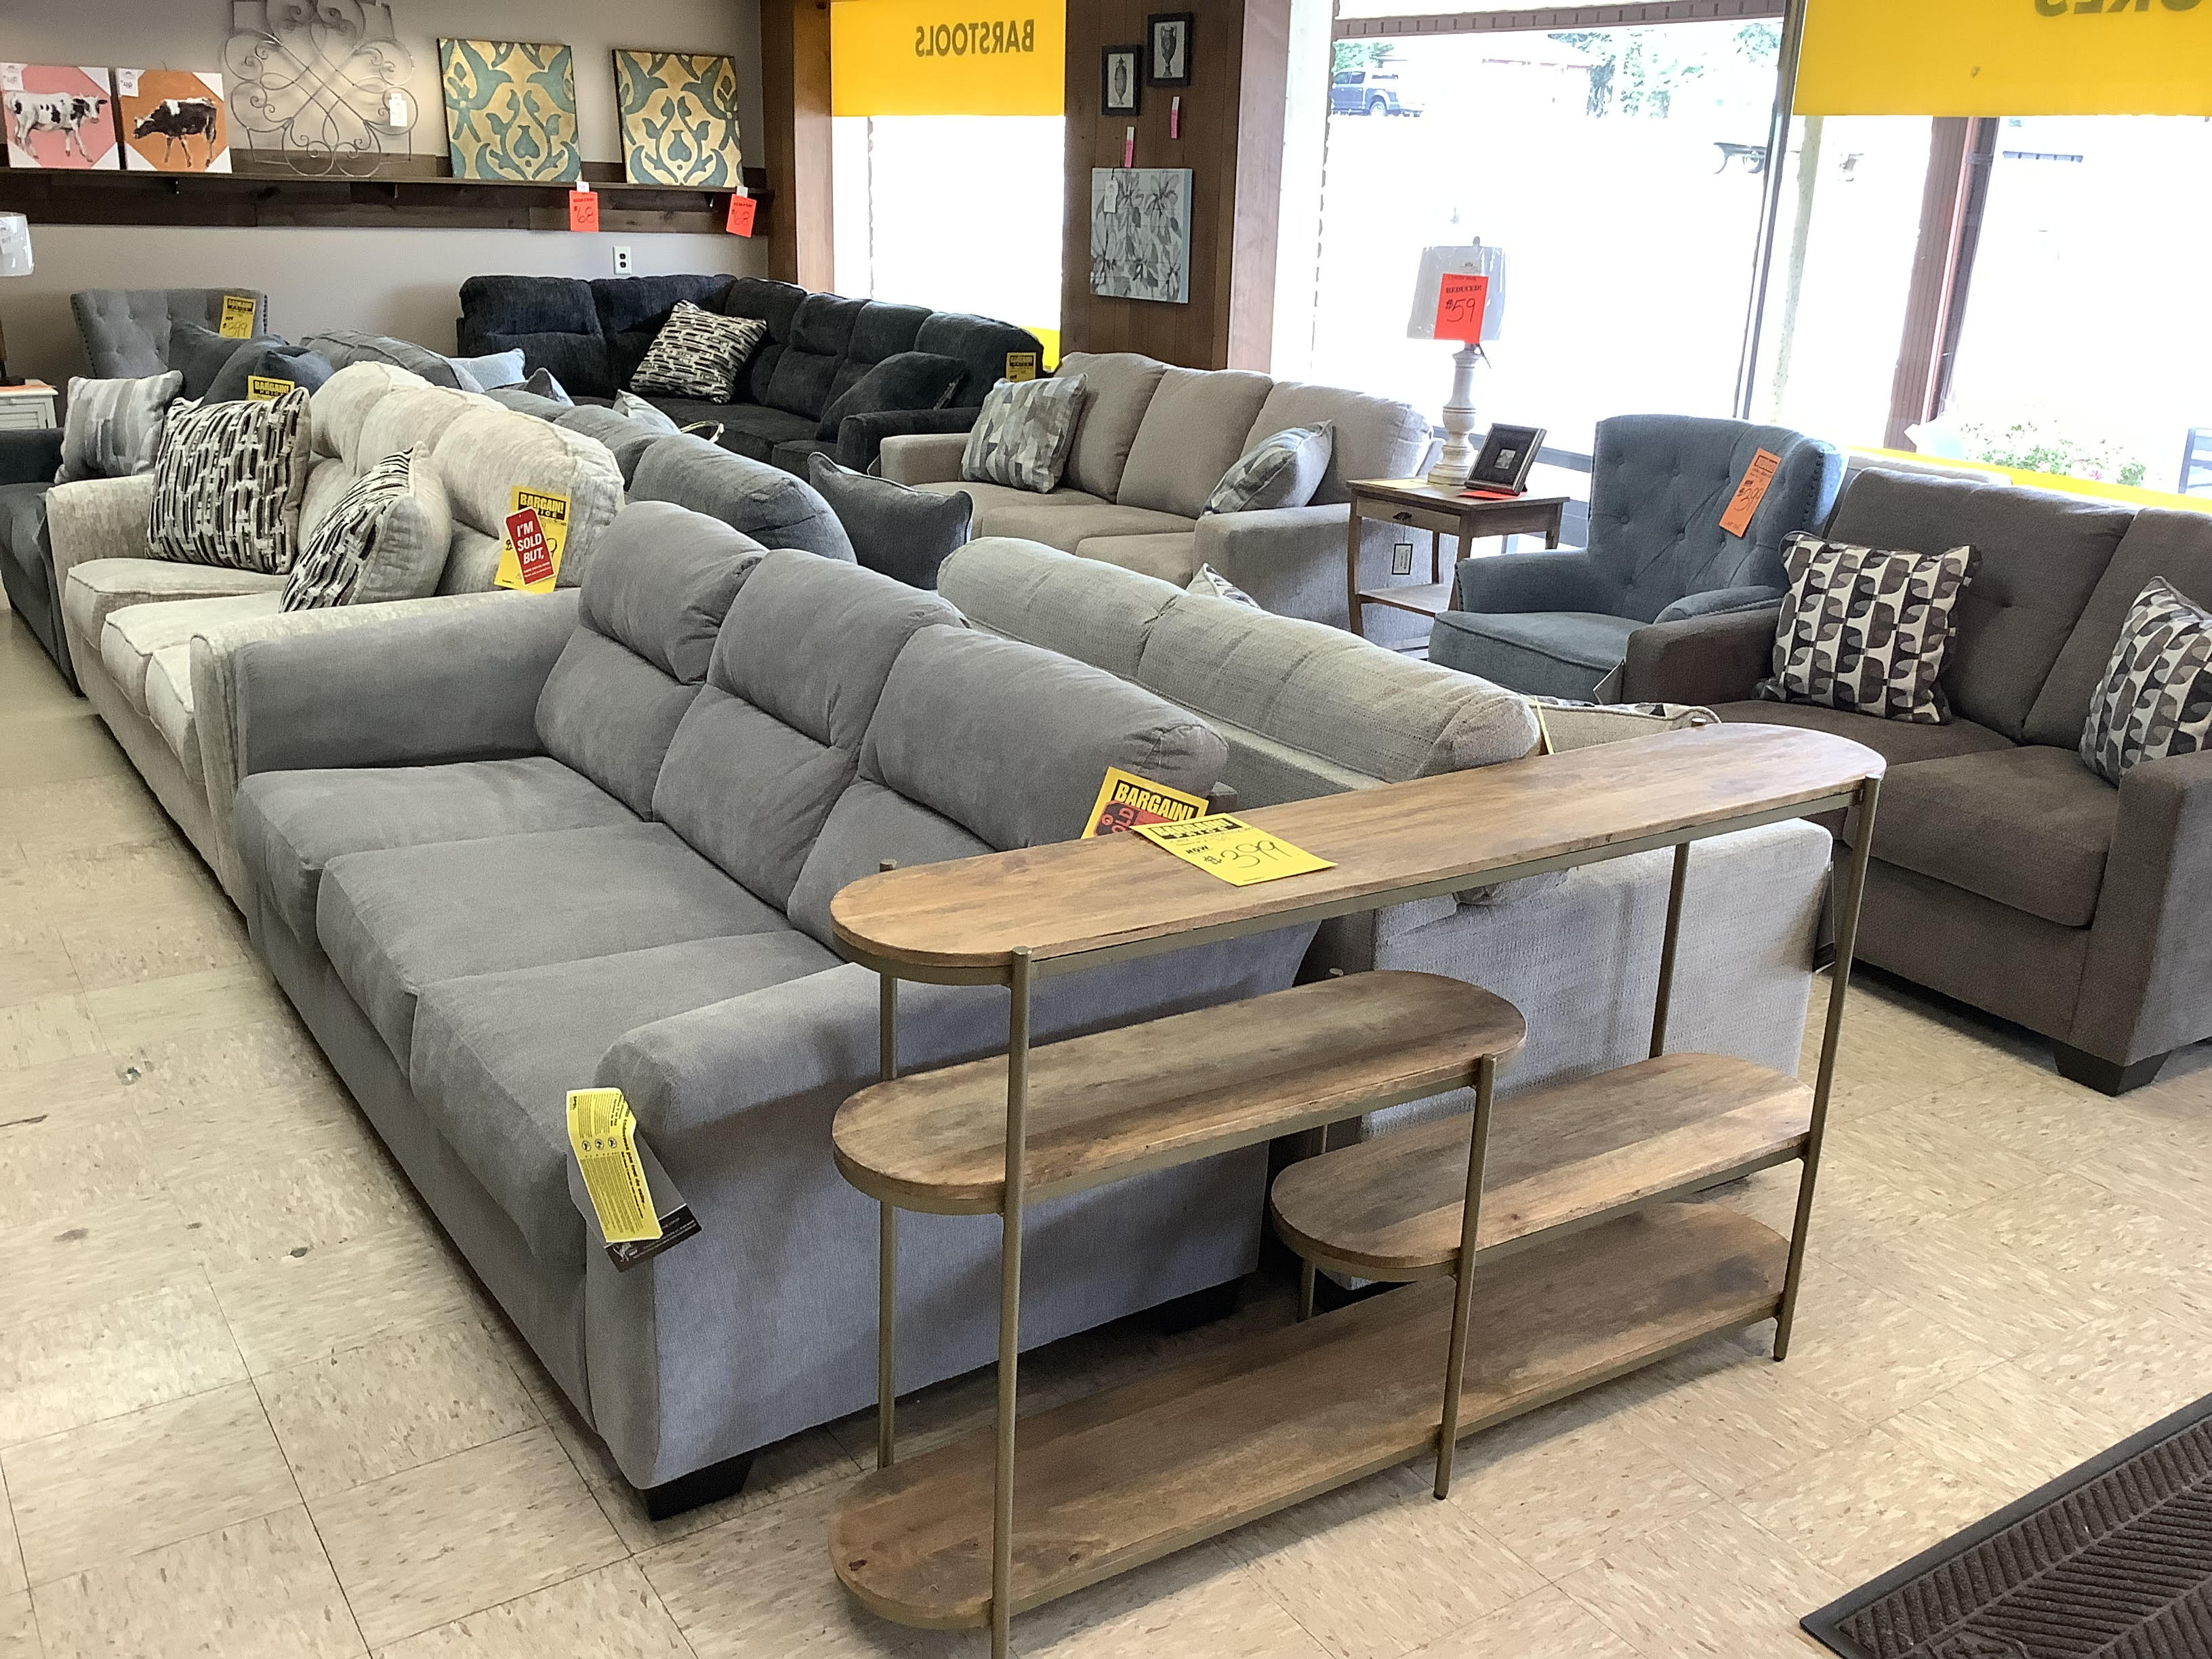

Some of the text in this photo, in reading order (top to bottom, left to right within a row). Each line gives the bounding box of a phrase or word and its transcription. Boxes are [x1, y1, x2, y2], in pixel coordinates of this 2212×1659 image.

[574, 205, 595, 223] $68
[1445, 298, 1475, 323] $59
[520, 493, 565, 514] BARGAIN!
[516, 520, 534, 537] I'M
[517, 534, 542, 552] SOLD
[523, 547, 545, 565] BUT,
[1114, 781, 1195, 822] BARGAIN!
[1111, 807, 1134, 833] OLD
[1150, 818, 1233, 836] BARGAIN!
[1185, 845, 1209, 855] NOW
[1204, 840, 1292, 869] $399
